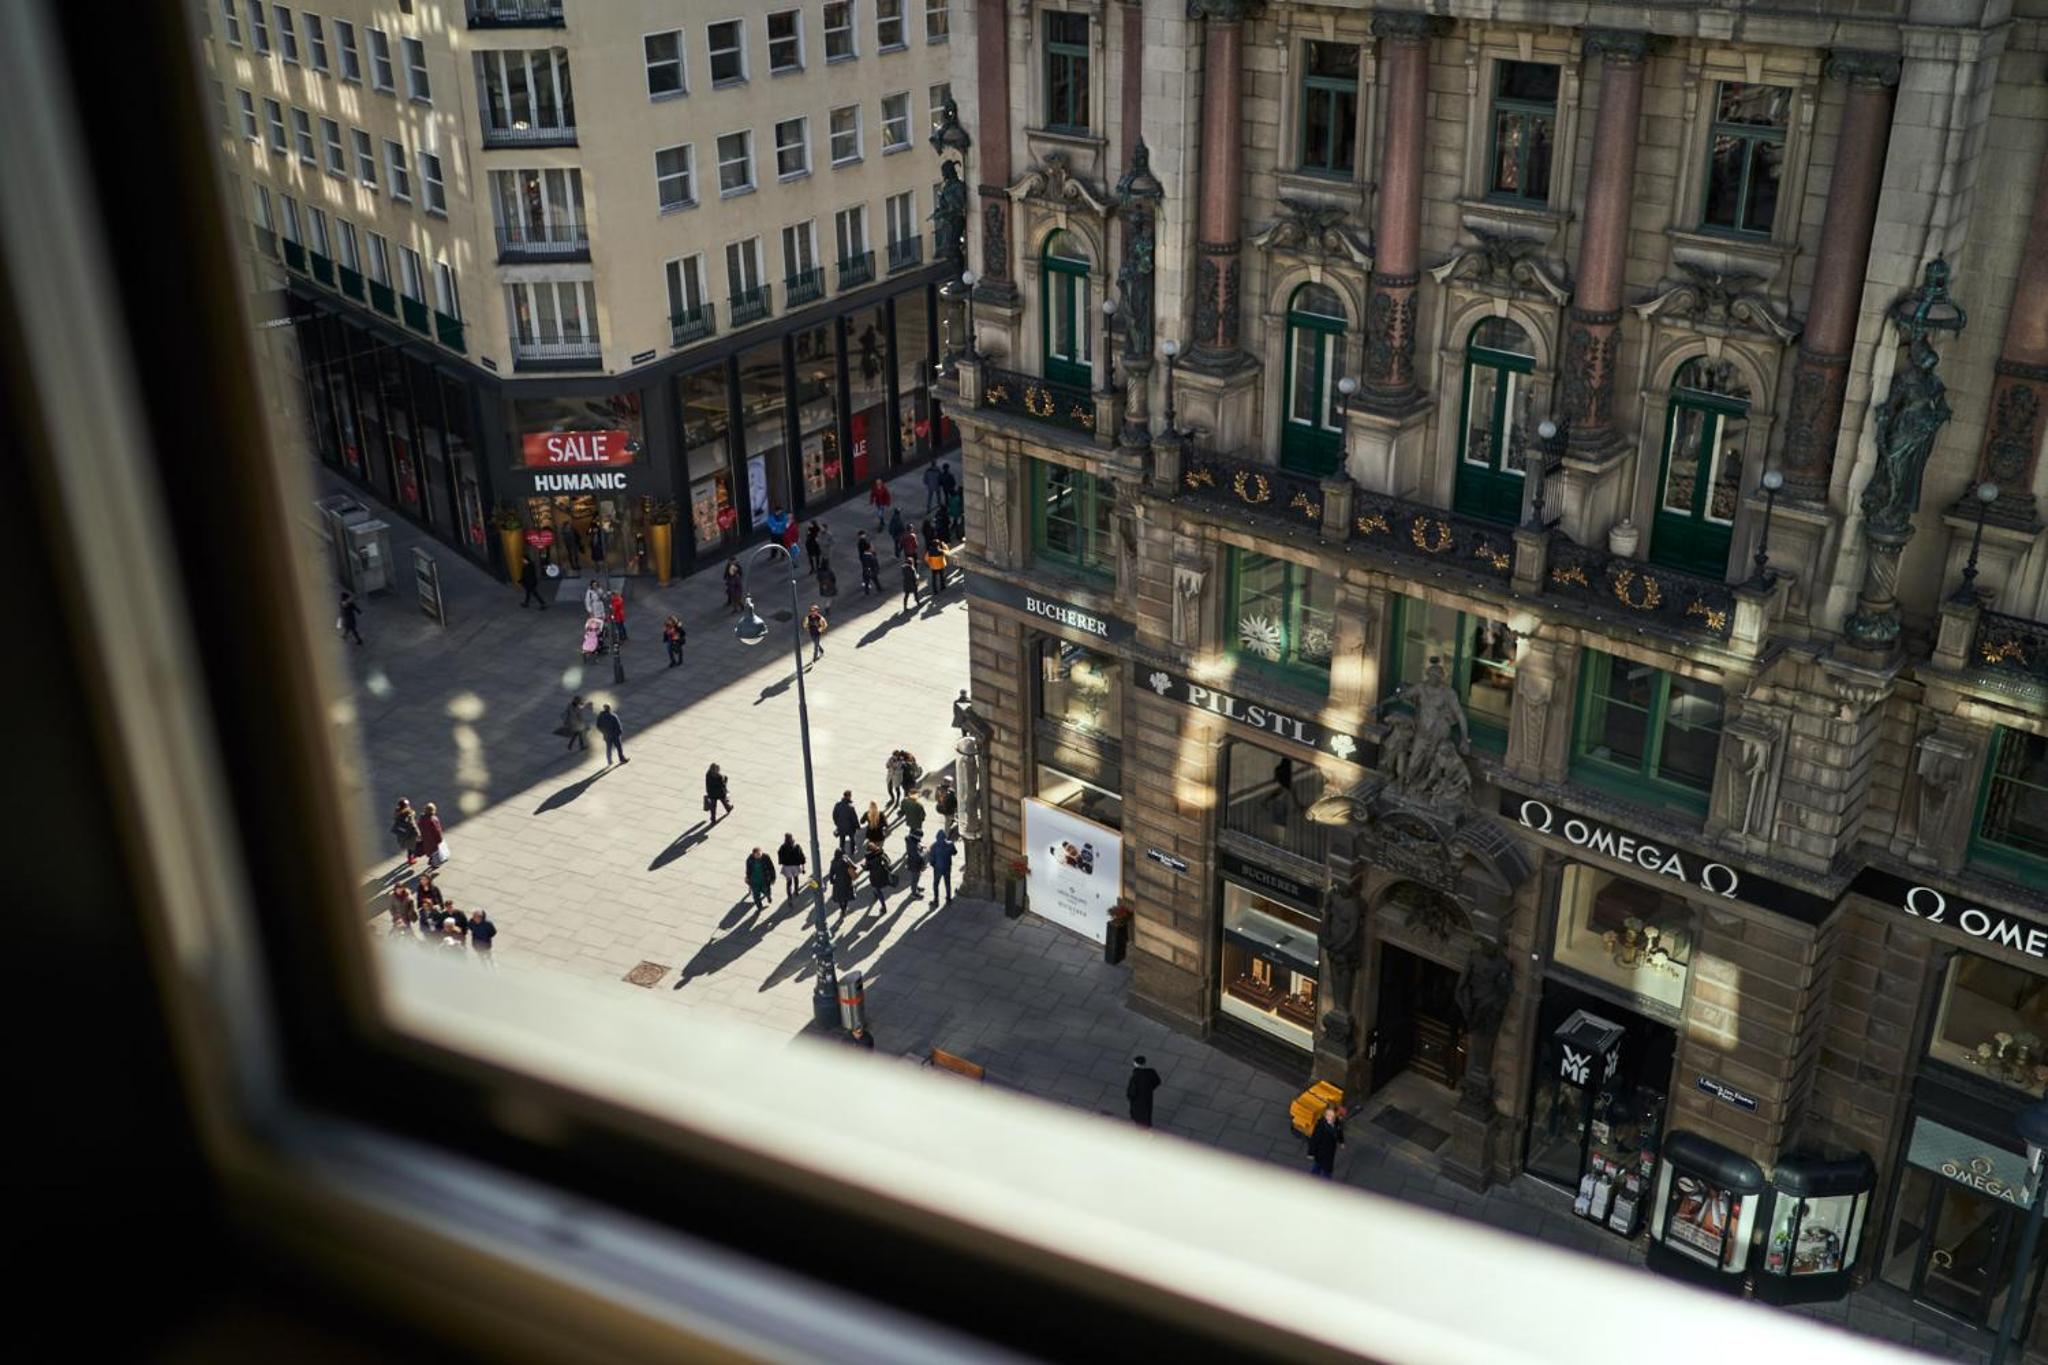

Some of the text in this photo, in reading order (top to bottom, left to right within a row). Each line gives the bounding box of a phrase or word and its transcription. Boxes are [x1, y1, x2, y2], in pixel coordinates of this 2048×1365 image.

[547, 436, 610, 463] SALE
[535, 473, 627, 492] HUMANIC
[1026, 597, 1108, 637] BUCHERER
[1187, 683, 1316, 746] PILSTL
[1564, 820, 1687, 882] OMEGA
[1960, 909, 2048, 958] OME
[1561, 1044, 1592, 1085] WMF
[1942, 1163, 2017, 1204] OMEGA
